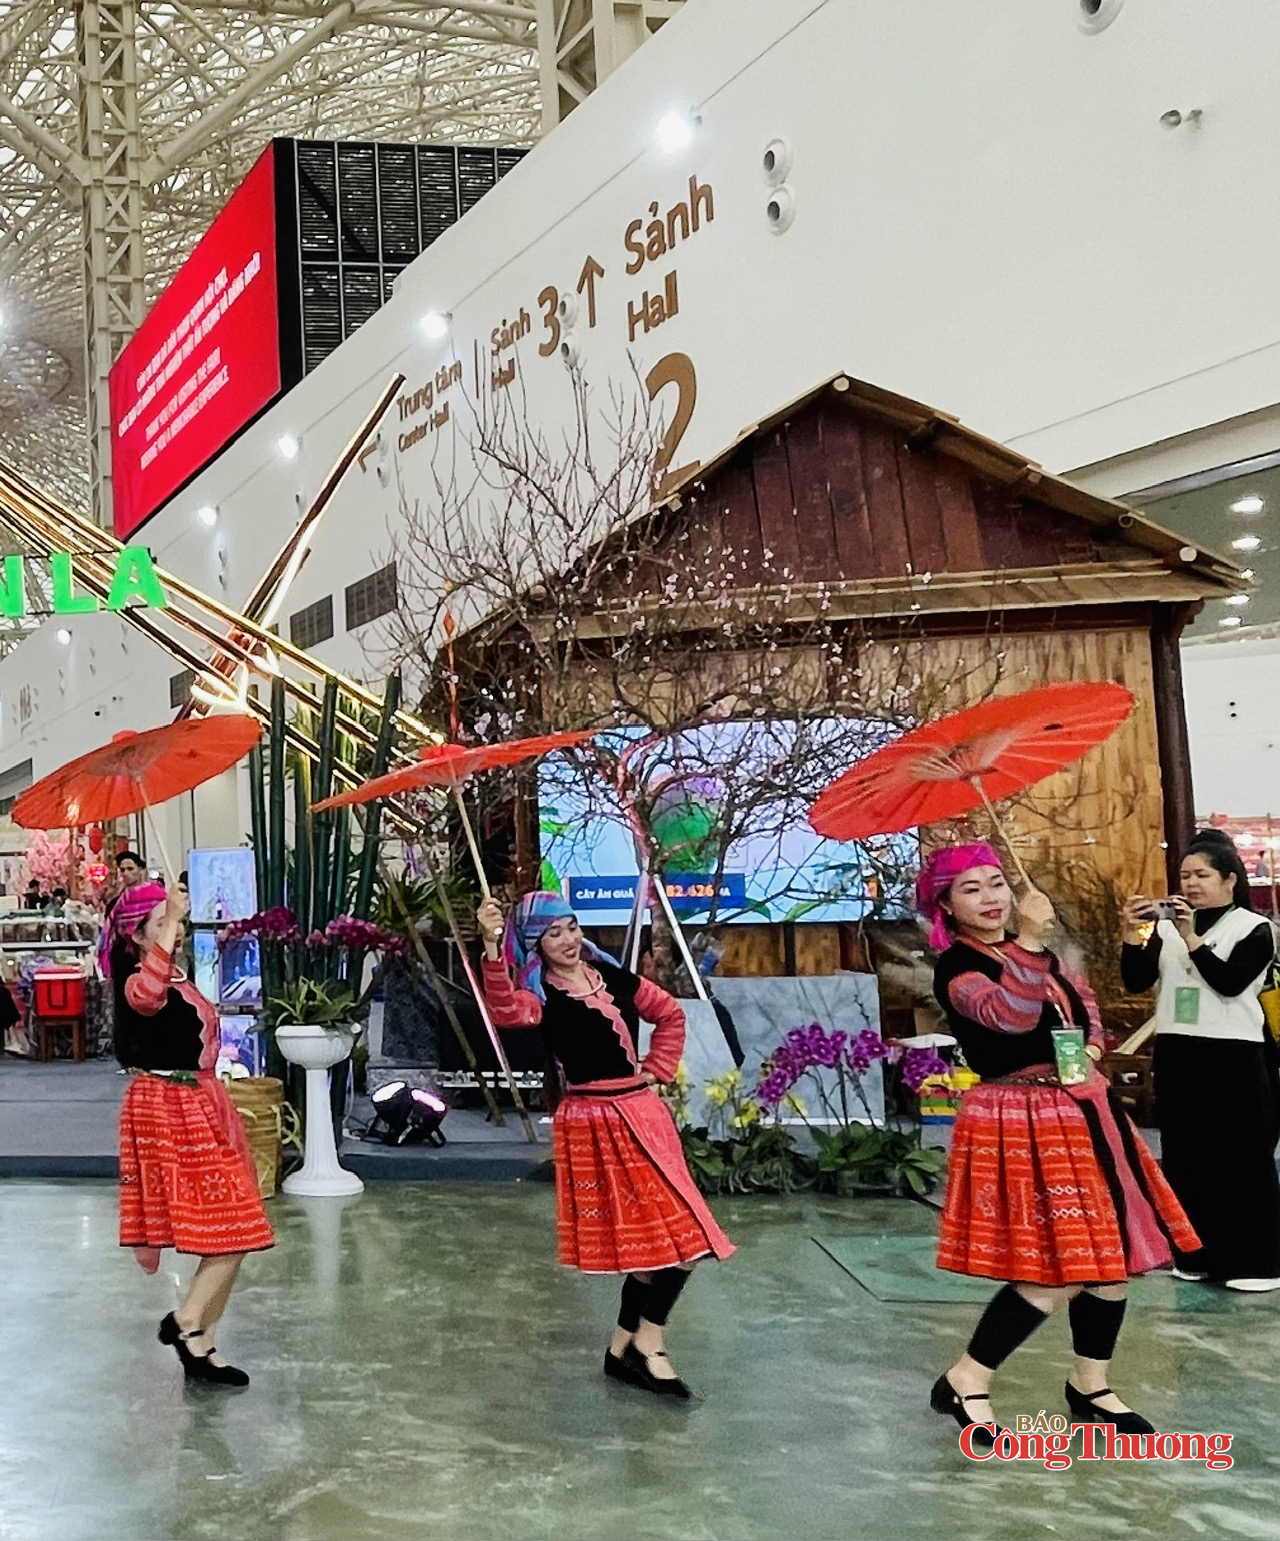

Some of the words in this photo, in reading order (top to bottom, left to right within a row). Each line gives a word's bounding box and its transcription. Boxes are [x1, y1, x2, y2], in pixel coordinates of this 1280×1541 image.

[624, 174, 714, 276] Sảnh
[490, 306, 531, 356] Sảnh
[537, 285, 561, 357] 3
[627, 269, 679, 343] Hall
[396, 381, 433, 422] Trung
[435, 359, 463, 394] tâm
[398, 422, 428, 453] Center
[429, 400, 450, 432] Hall
[645, 352, 701, 505] 2
[50, 546, 168, 615] LA
